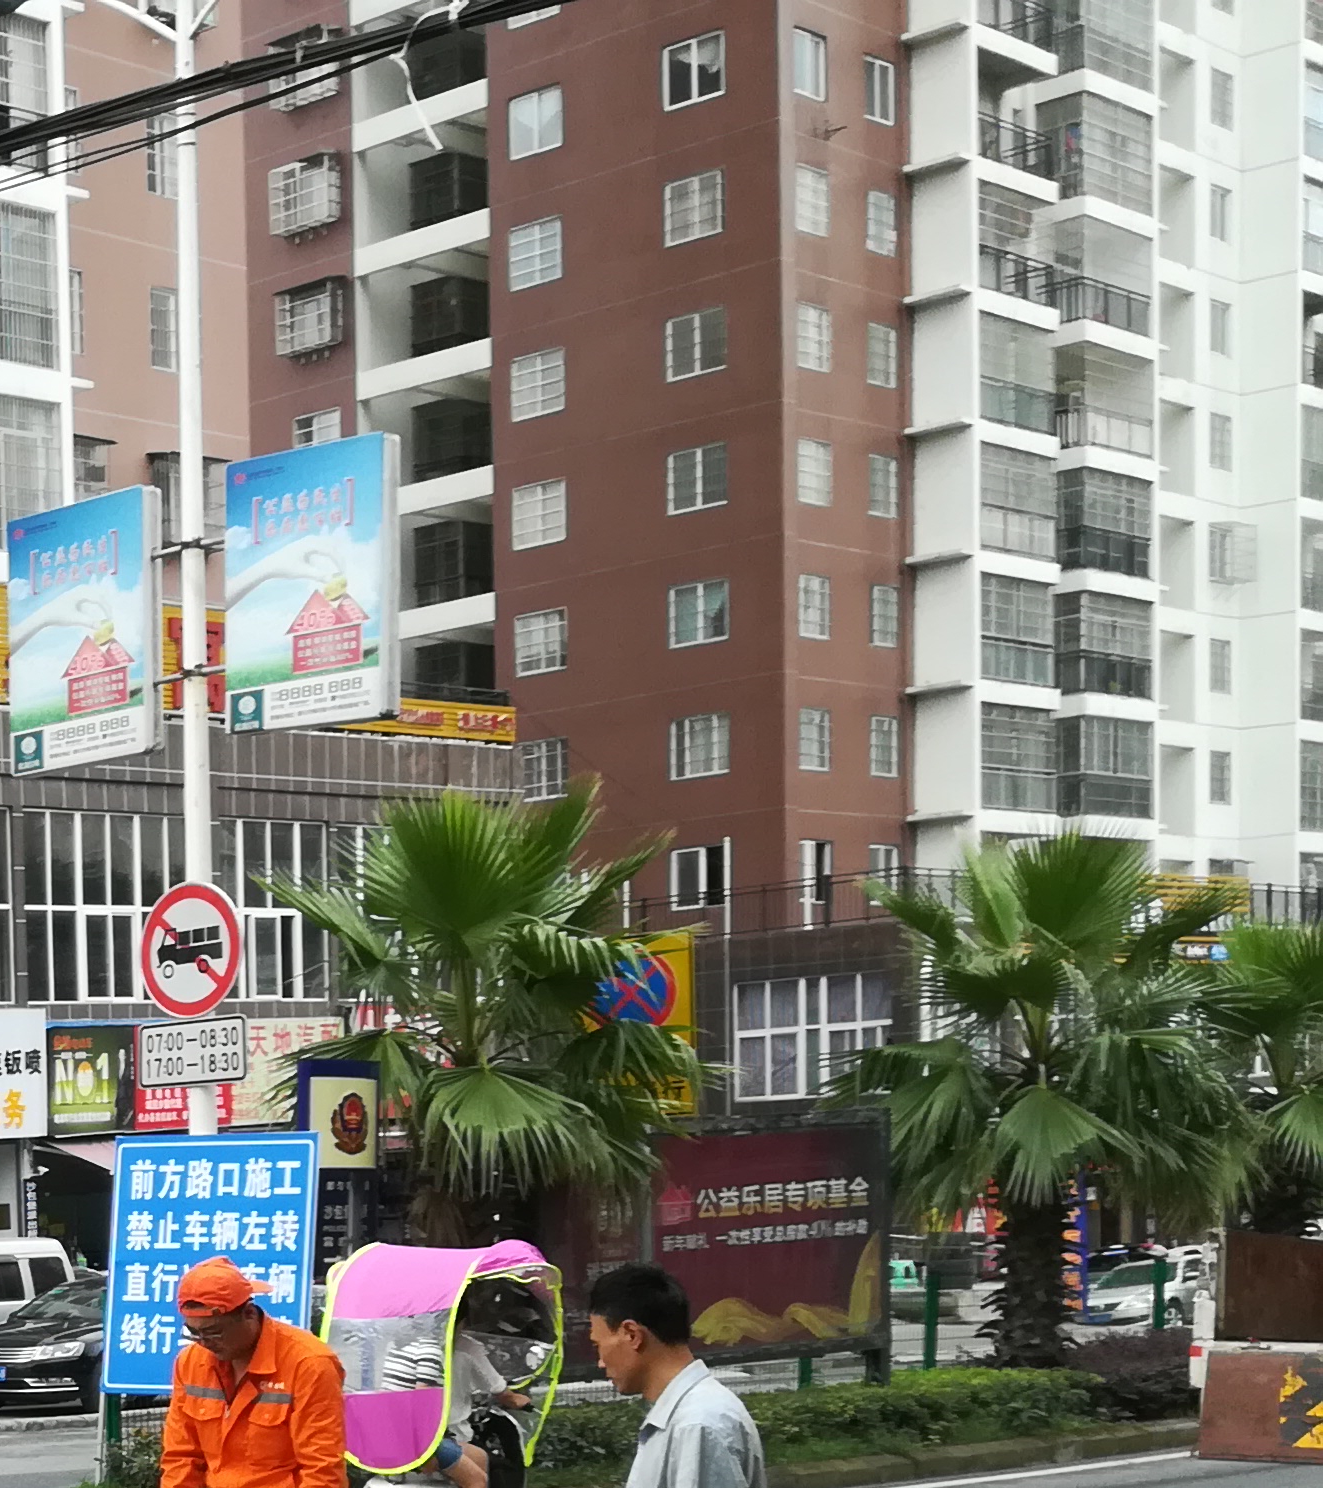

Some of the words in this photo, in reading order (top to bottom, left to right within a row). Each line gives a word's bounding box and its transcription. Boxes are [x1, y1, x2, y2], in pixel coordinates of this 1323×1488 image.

[129, 1158, 302, 1200] 前方路口施工
[696, 1177, 869, 1219] 公益乐居专项基金
[125, 1210, 299, 1251] 禁止车辆左转
